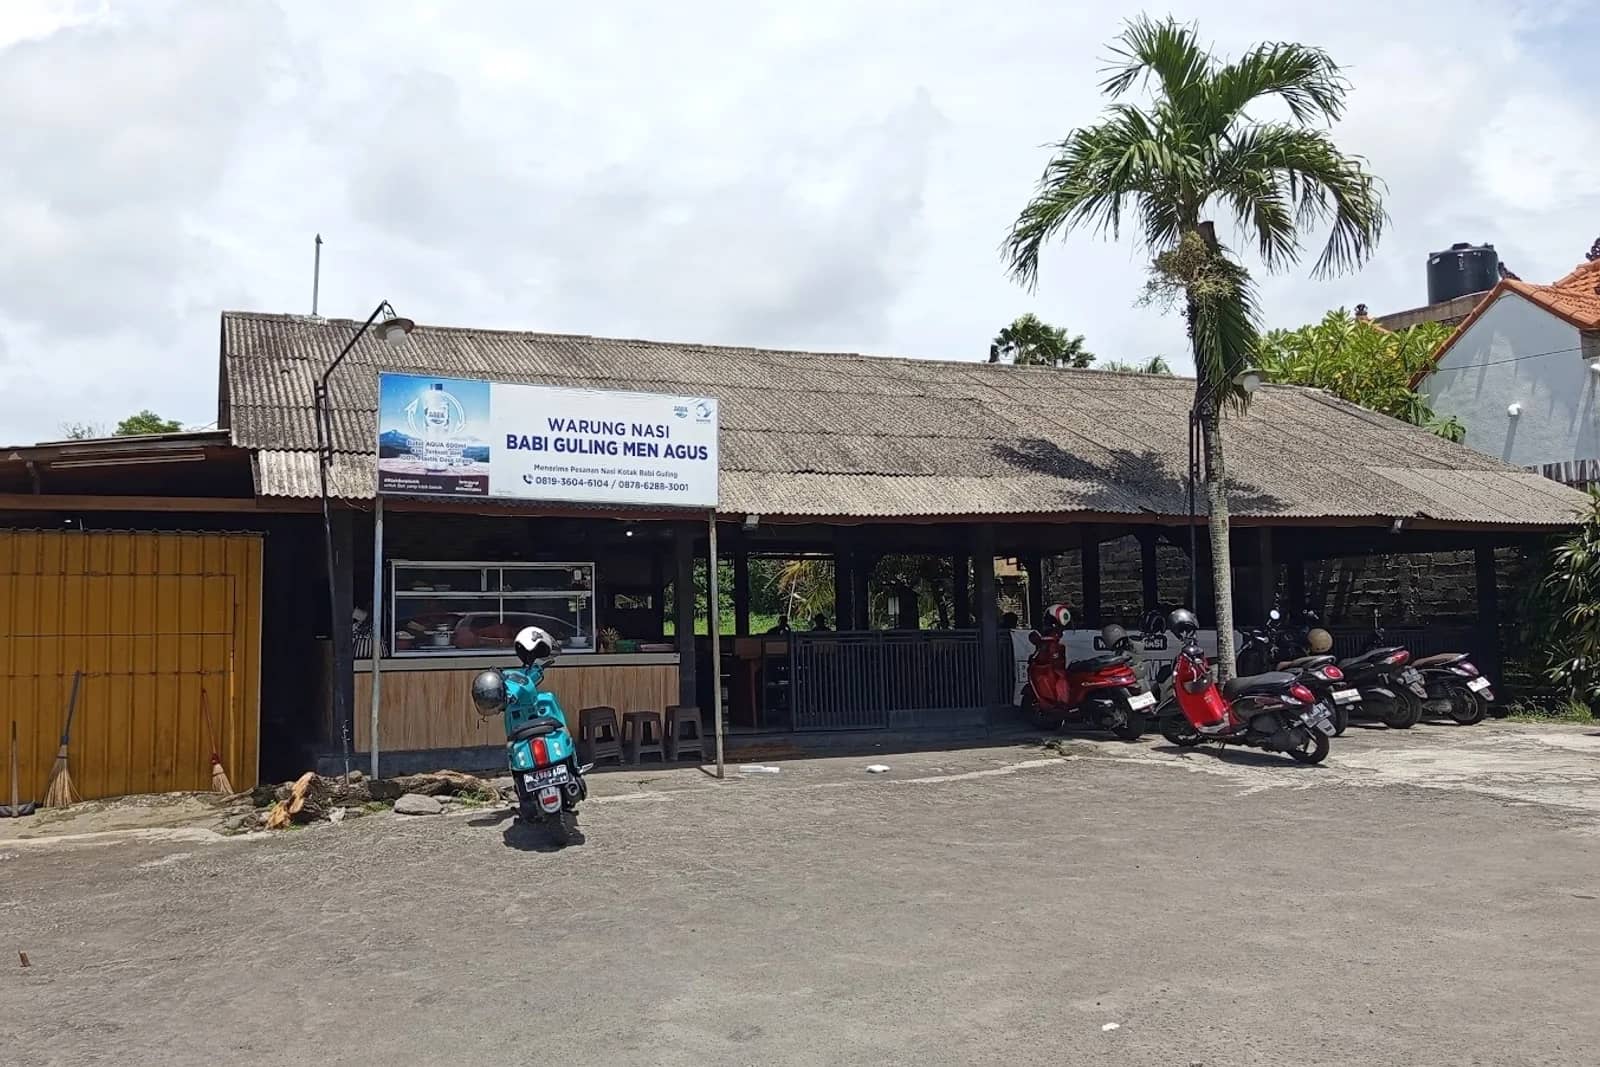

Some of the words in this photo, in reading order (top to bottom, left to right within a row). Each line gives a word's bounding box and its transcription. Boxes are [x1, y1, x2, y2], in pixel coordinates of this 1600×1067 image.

[548, 417, 626, 436] WARUNG
[631, 423, 670, 439] NASI
[506, 433, 549, 452] BABI
[553, 437, 619, 456] GULING
[623, 441, 659, 458] MEN
[663, 444, 709, 461] AGUS
[533, 463, 569, 473] Menerima
[570, 465, 599, 474] Pesanan
[601, 467, 616, 475] Nasi
[617, 468, 637, 476] Kotak
[639, 469, 655, 477] Babi
[655, 470, 678, 479] Guling
[535, 476, 609, 488] 0819-3604-6104
[618, 480, 689, 492] 0878-6288-3001
